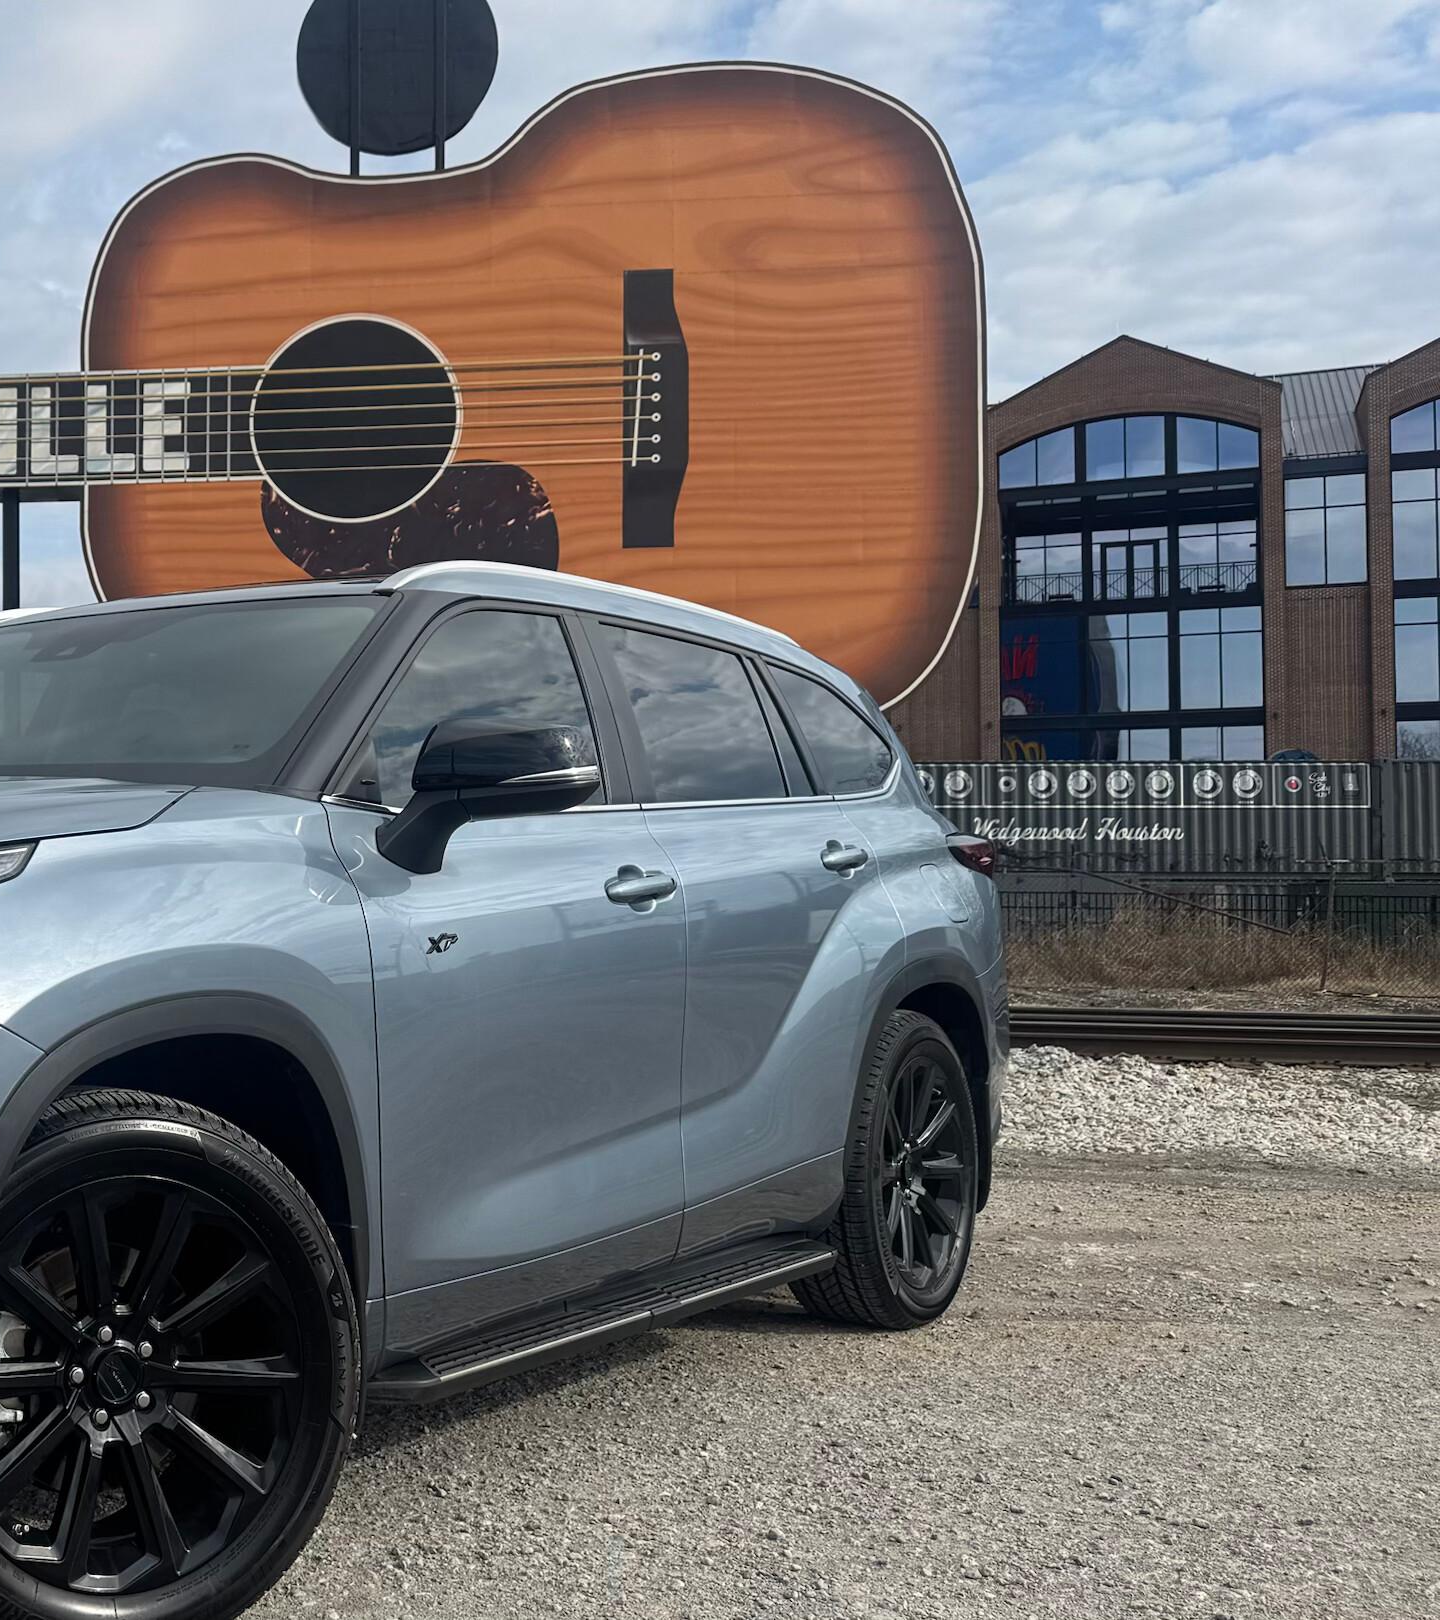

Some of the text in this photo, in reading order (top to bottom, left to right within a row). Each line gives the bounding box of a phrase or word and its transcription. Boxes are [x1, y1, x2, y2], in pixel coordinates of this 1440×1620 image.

[973, 817, 1185, 847] Wedgewood Houston
[223, 1147, 327, 1268] BRIDGESTONE
[334, 1330, 347, 1410] ALENZA
